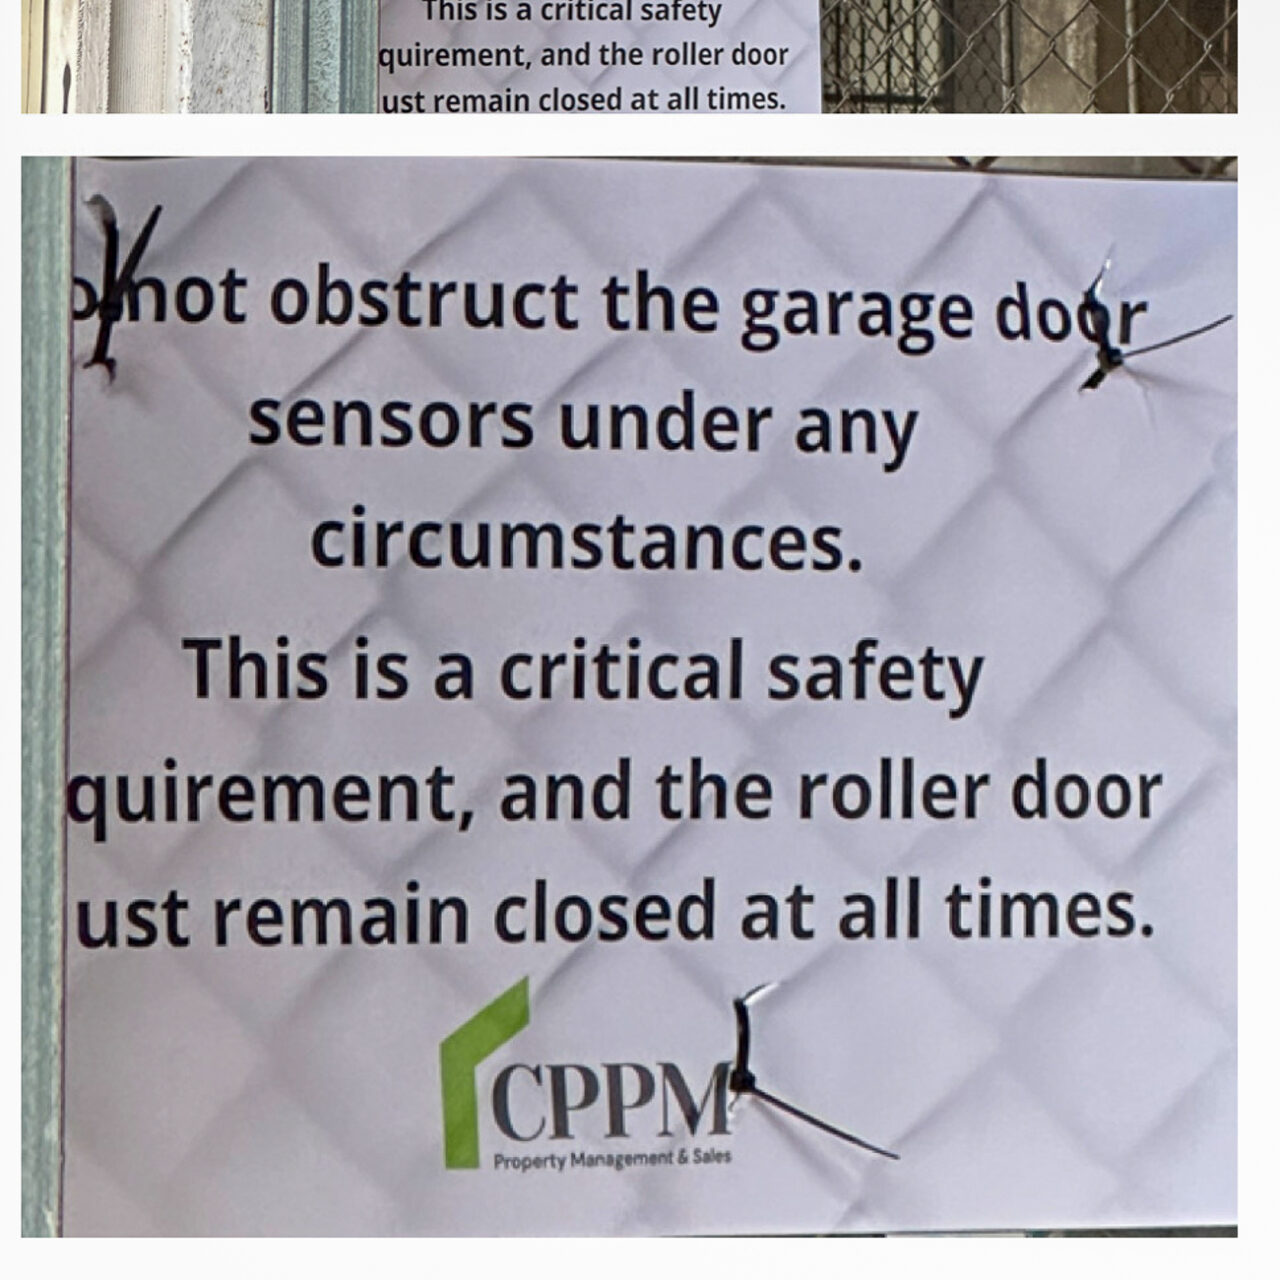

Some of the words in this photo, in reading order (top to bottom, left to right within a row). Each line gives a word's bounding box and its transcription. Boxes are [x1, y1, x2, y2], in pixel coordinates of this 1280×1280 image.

[517, 3, 531, 20] a
[541, 42, 589, 66] and
[599, 42, 642, 65] the
[653, 42, 724, 65] roller
[732, 42, 788, 65] door
[435, 88, 529, 112] remain
[539, 87, 621, 111] closed
[631, 90, 658, 110] at
[670, 87, 698, 110] all
[708, 87, 785, 109] times.
[125, 266, 246, 323] not
[271, 263, 578, 329] obstruct
[602, 270, 718, 332] the
[742, 289, 972, 355] garage
[995, 279, 1149, 343] door
[250, 399, 533, 448] sensors
[561, 389, 772, 451] under
[797, 409, 918, 472] any
[312, 505, 861, 571] circumstances.
[182, 635, 327, 699] This
[356, 636, 408, 699] is
[435, 653, 472, 699] a
[502, 637, 742, 699] critical
[769, 639, 983, 718] safety
[501, 758, 630, 821] and
[656, 757, 771, 819] the
[801, 758, 989, 819] roller
[1013, 758, 1162, 818] door
[216, 881, 467, 946] remain
[495, 878, 714, 942] closed
[742, 886, 813, 939] at
[840, 877, 919, 939] all
[946, 877, 1152, 937] times.
[492, 1061, 733, 1141] CPPM
[494, 1153, 566, 1173] Property
[571, 1150, 674, 1170] Management
[678, 1149, 688, 1163] &
[693, 1148, 732, 1163] Sales
